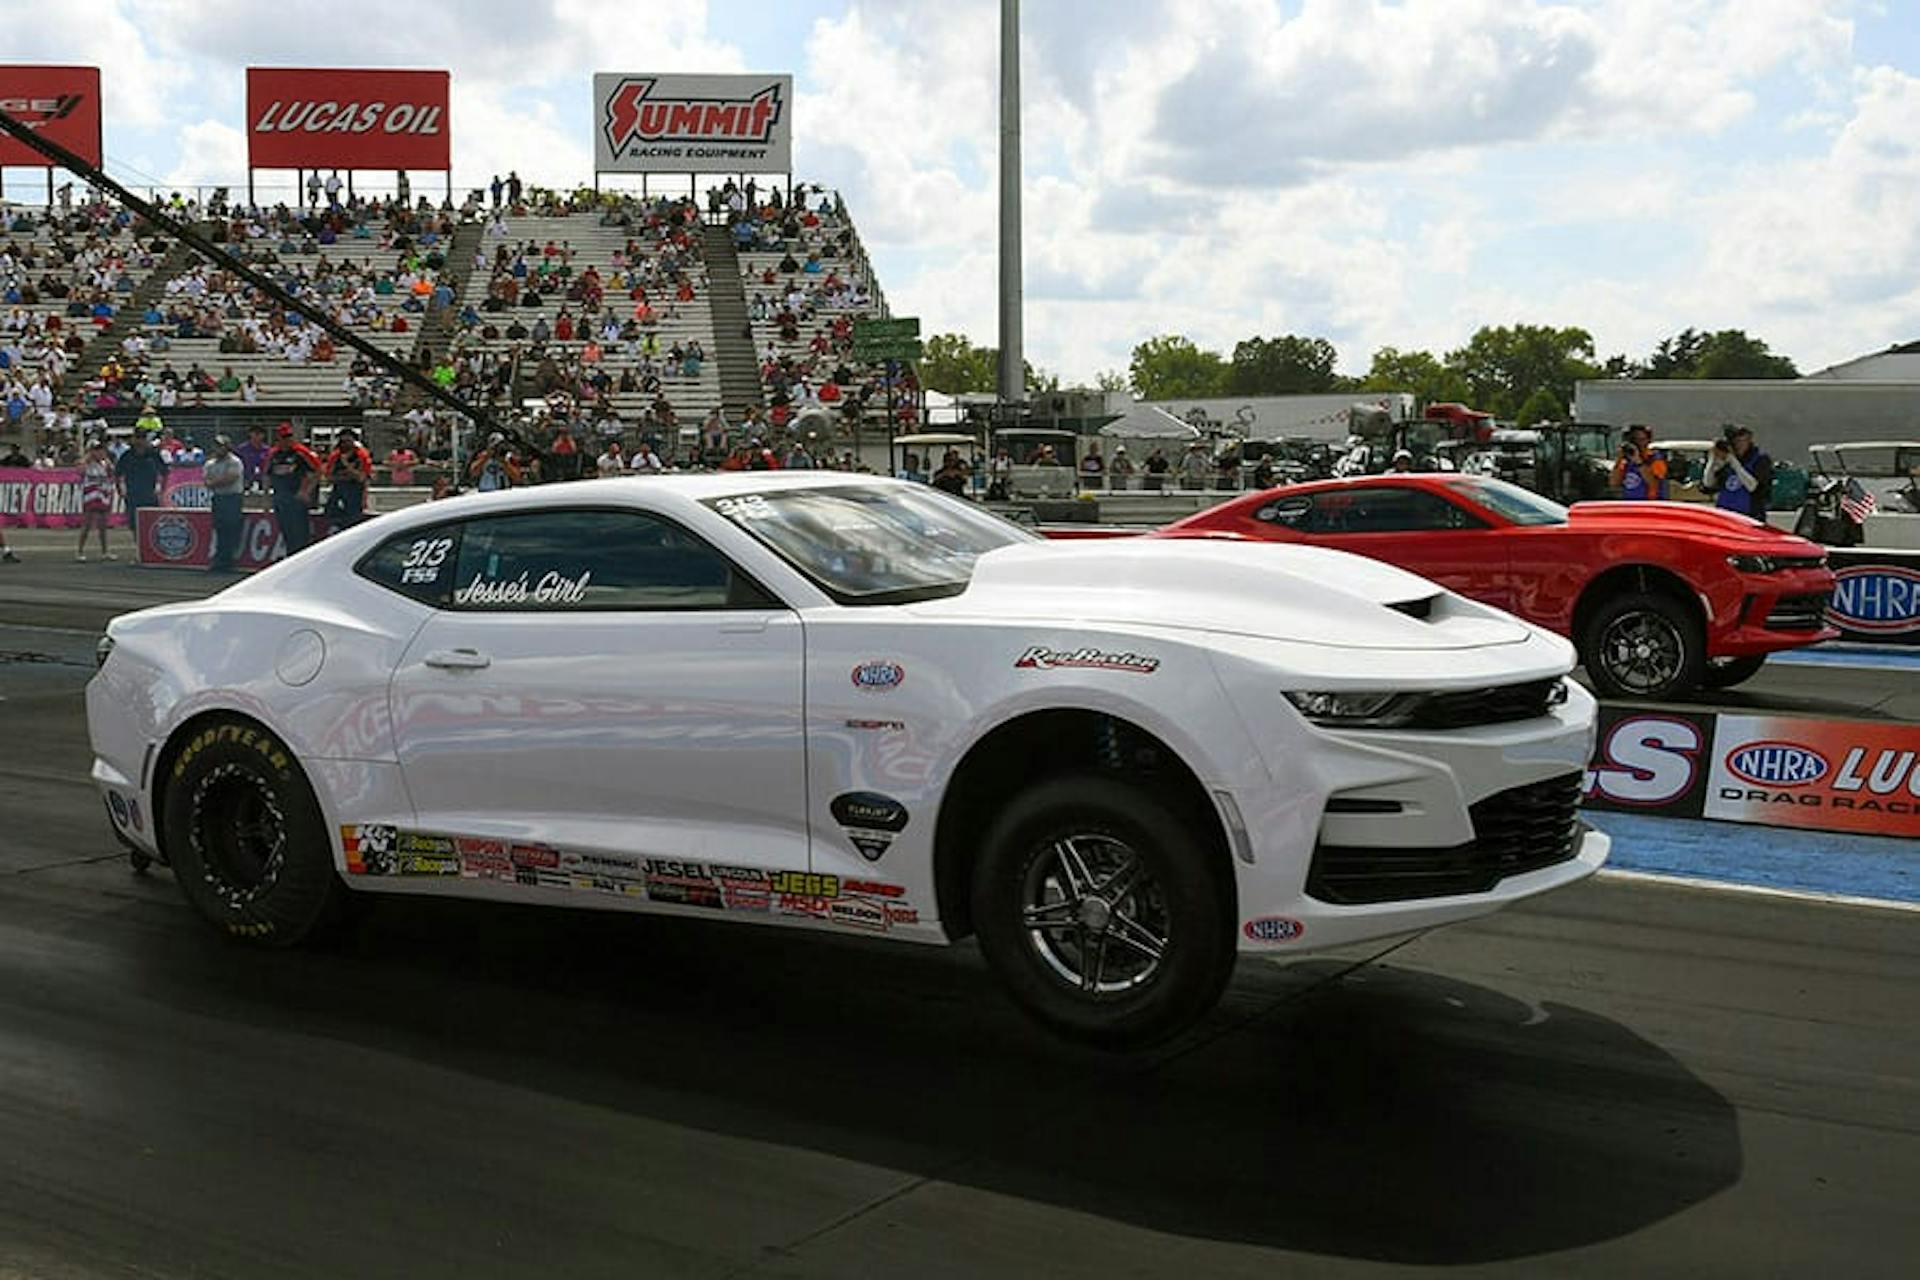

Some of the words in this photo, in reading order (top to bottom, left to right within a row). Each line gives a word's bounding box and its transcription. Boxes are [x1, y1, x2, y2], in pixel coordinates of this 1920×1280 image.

[254, 101, 385, 132] LUCAS
[384, 103, 441, 133] OIL
[629, 149, 681, 158] RACING
[687, 149, 766, 159] EQUIPMENT
[171, 485, 214, 507] NHR
[402, 538, 452, 567] 313
[454, 570, 529, 603] Jesse's
[535, 570, 591, 603] Girl
[858, 665, 898, 685] NHRA
[1741, 748, 1817, 781] NHRA
[1720, 788, 1823, 806] DRAG
[773, 871, 838, 896] JEGS
[1252, 920, 1297, 939] NHRA
